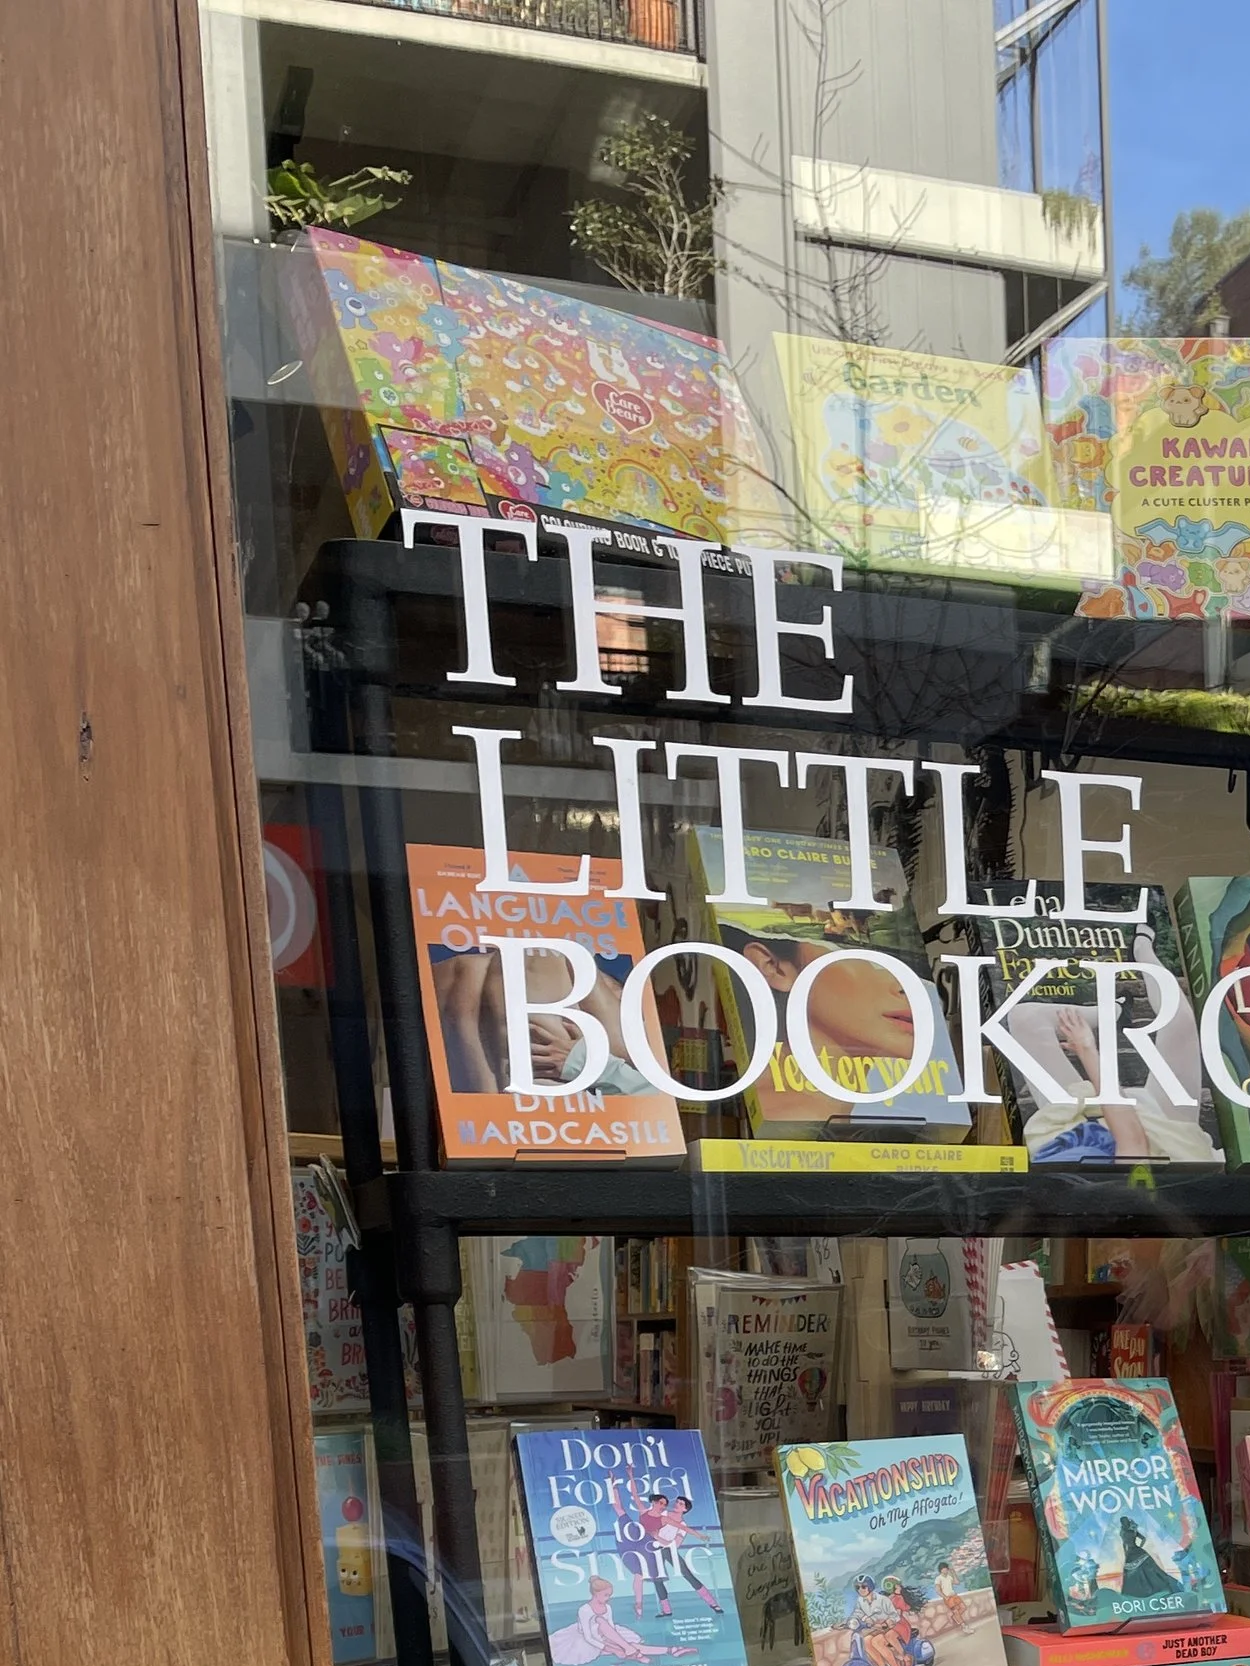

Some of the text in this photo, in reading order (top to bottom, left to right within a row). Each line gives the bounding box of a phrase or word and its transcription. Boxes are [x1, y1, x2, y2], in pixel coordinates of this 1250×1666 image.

[843, 362, 982, 408] Garden
[604, 399, 646, 425] Bears
[609, 391, 641, 413] Care
[1141, 498, 1149, 506] A
[1153, 498, 1185, 507] CUTE
[1188, 498, 1241, 507] CLUSTER
[400, 508, 854, 714] THE
[451, 725, 1151, 925] LITTLE
[416, 888, 629, 928] LANGUAGE
[992, 918, 1128, 950] Dunham
[1177, 894, 1209, 998] LAND
[458, 1120, 671, 1146] HARDCASTLE
[738, 1143, 963, 1170] Yesteryear CARO CLAIRE
[727, 1310, 828, 1334] REMINDER
[560, 1436, 670, 1471] Don't
[795, 1454, 960, 1521] VACATIONSHIP
[1062, 1455, 1169, 1488] MIRROR
[548, 1466, 694, 1512] Forget
[1070, 1485, 1172, 1514] WOVEN
[869, 1493, 963, 1530] Oh My Affogato!
[614, 1521, 646, 1542] to
[550, 1540, 714, 1587] Smile
[1112, 1596, 1184, 1615] BORI CSER
[1162, 1635, 1227, 1649] JUST ANOTHER
[1176, 1647, 1217, 1659] DEAD BOY
